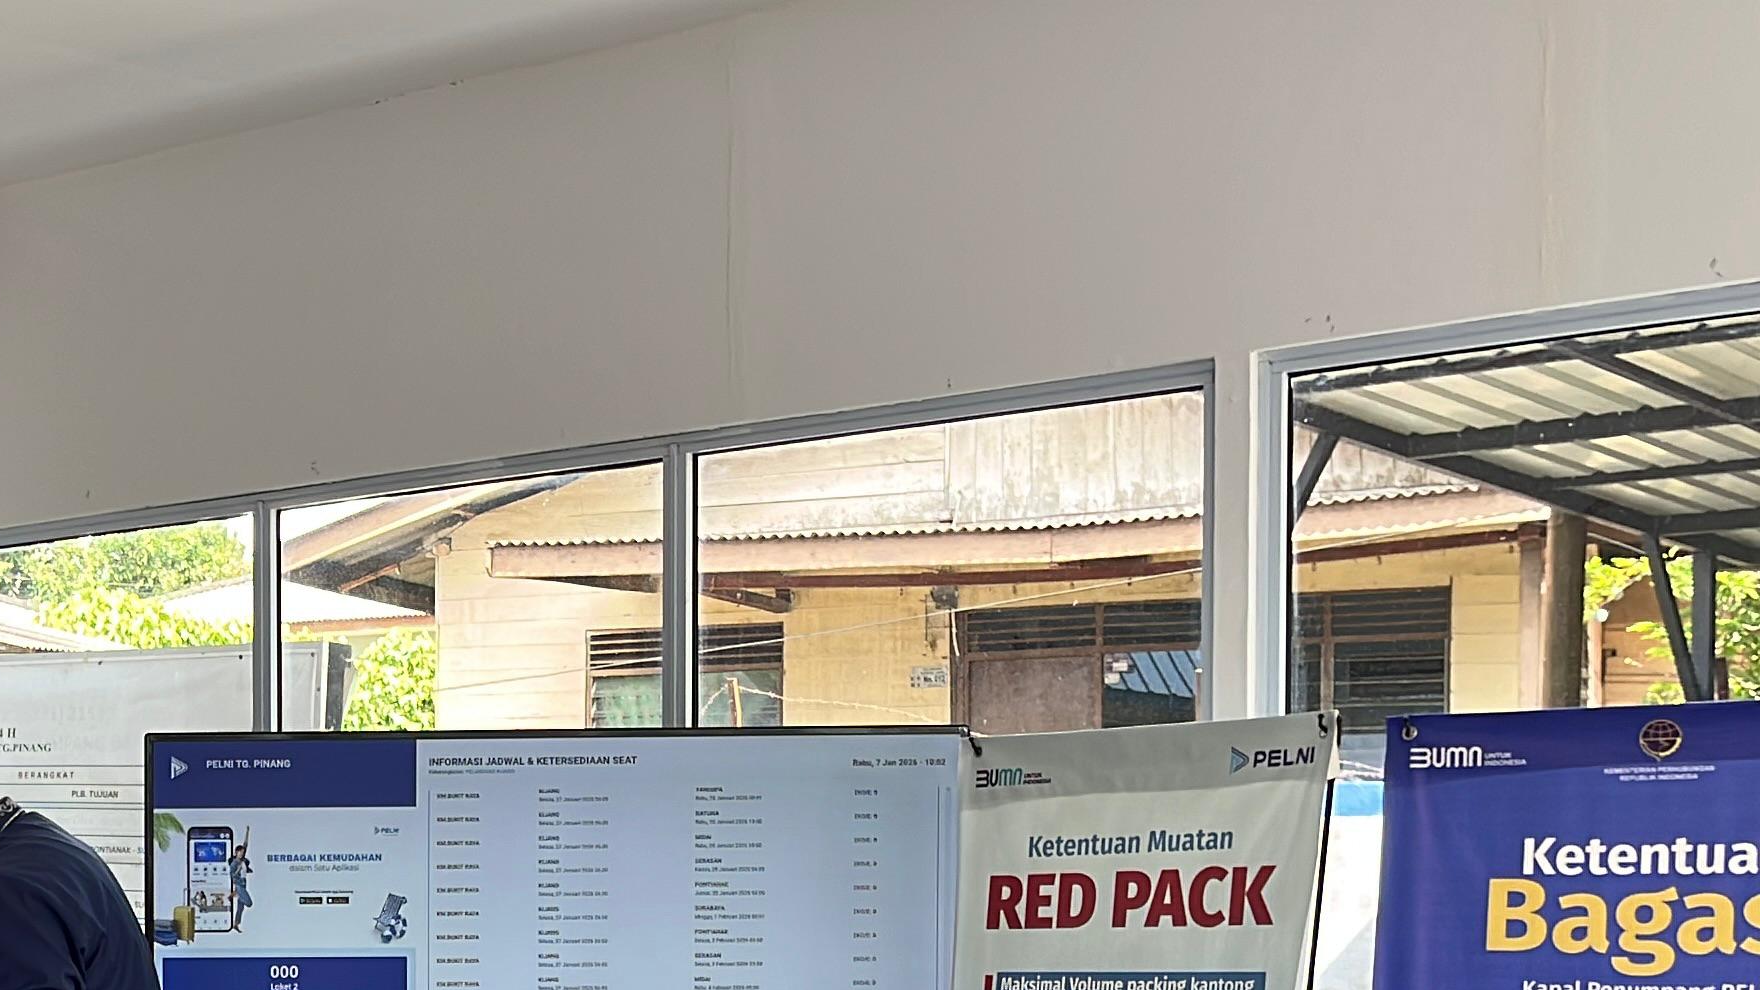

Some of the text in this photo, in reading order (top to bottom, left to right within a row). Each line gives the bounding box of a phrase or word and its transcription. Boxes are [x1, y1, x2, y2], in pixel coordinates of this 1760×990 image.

[7, 728, 16, 738] H
[428, 755, 638, 767] INFORMASI JADWAL & KETERSEDIAAN SEAT
[1252, 746, 1315, 768] PELNI
[206, 759, 291, 769] PELNI TG. PINANG
[18, 771, 74, 779] BERANGKAT
[89, 790, 119, 798] TUJUAN
[1028, 829, 1233, 858] Ketentuan Muatan
[319, 853, 382, 862] KEMUDAHAN
[986, 865, 1277, 930] RED PACK
[270, 965, 299, 979] 000
[270, 983, 298, 990] Loket 2
